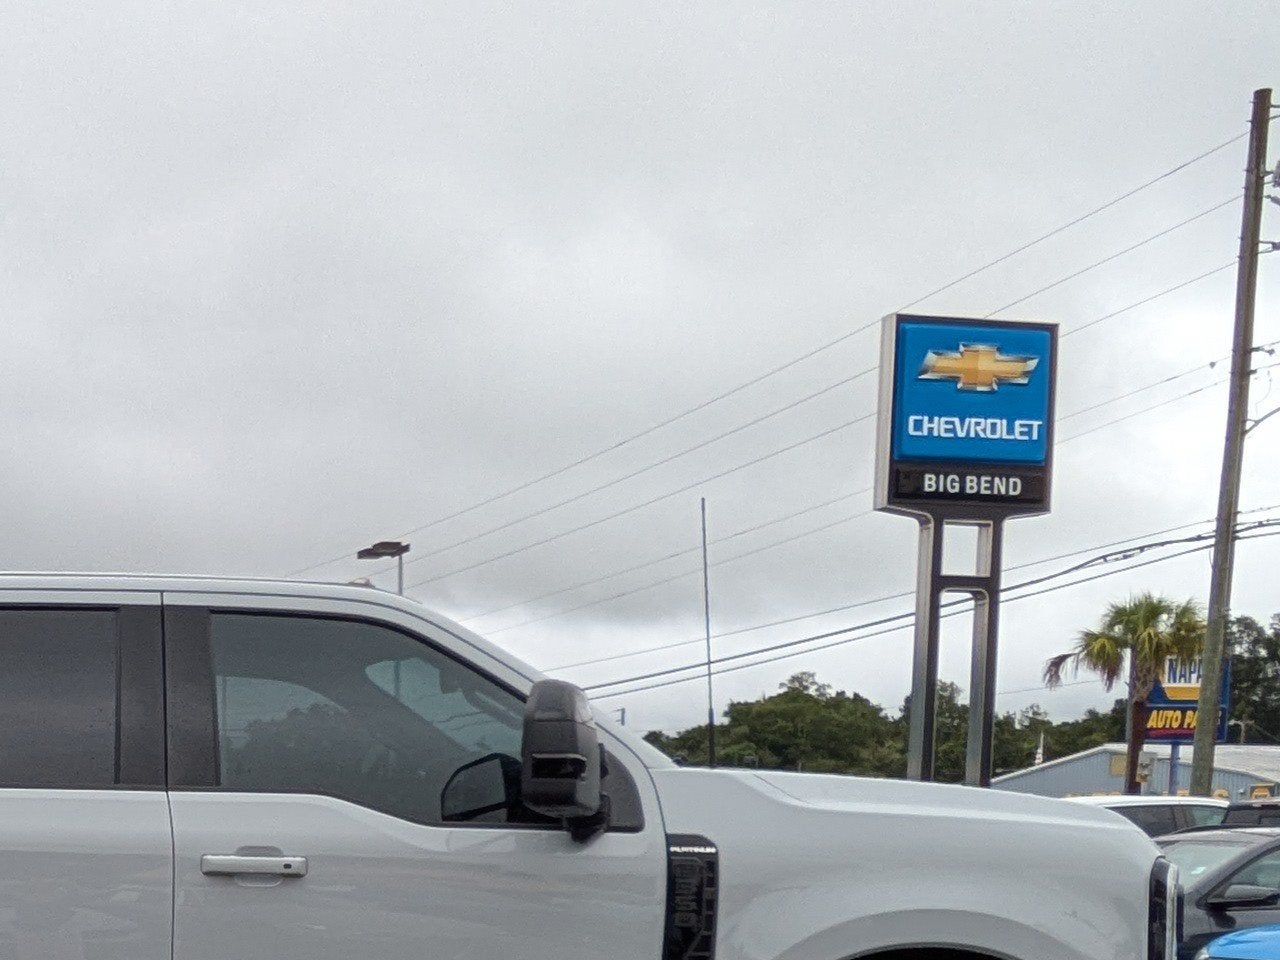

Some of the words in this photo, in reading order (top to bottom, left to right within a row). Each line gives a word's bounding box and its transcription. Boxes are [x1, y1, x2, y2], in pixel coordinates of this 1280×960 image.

[908, 415, 1042, 441] CHEVROLET
[923, 473, 960, 493] BIG
[965, 475, 1022, 496] BEND
[1147, 709, 1182, 728] AUTO
